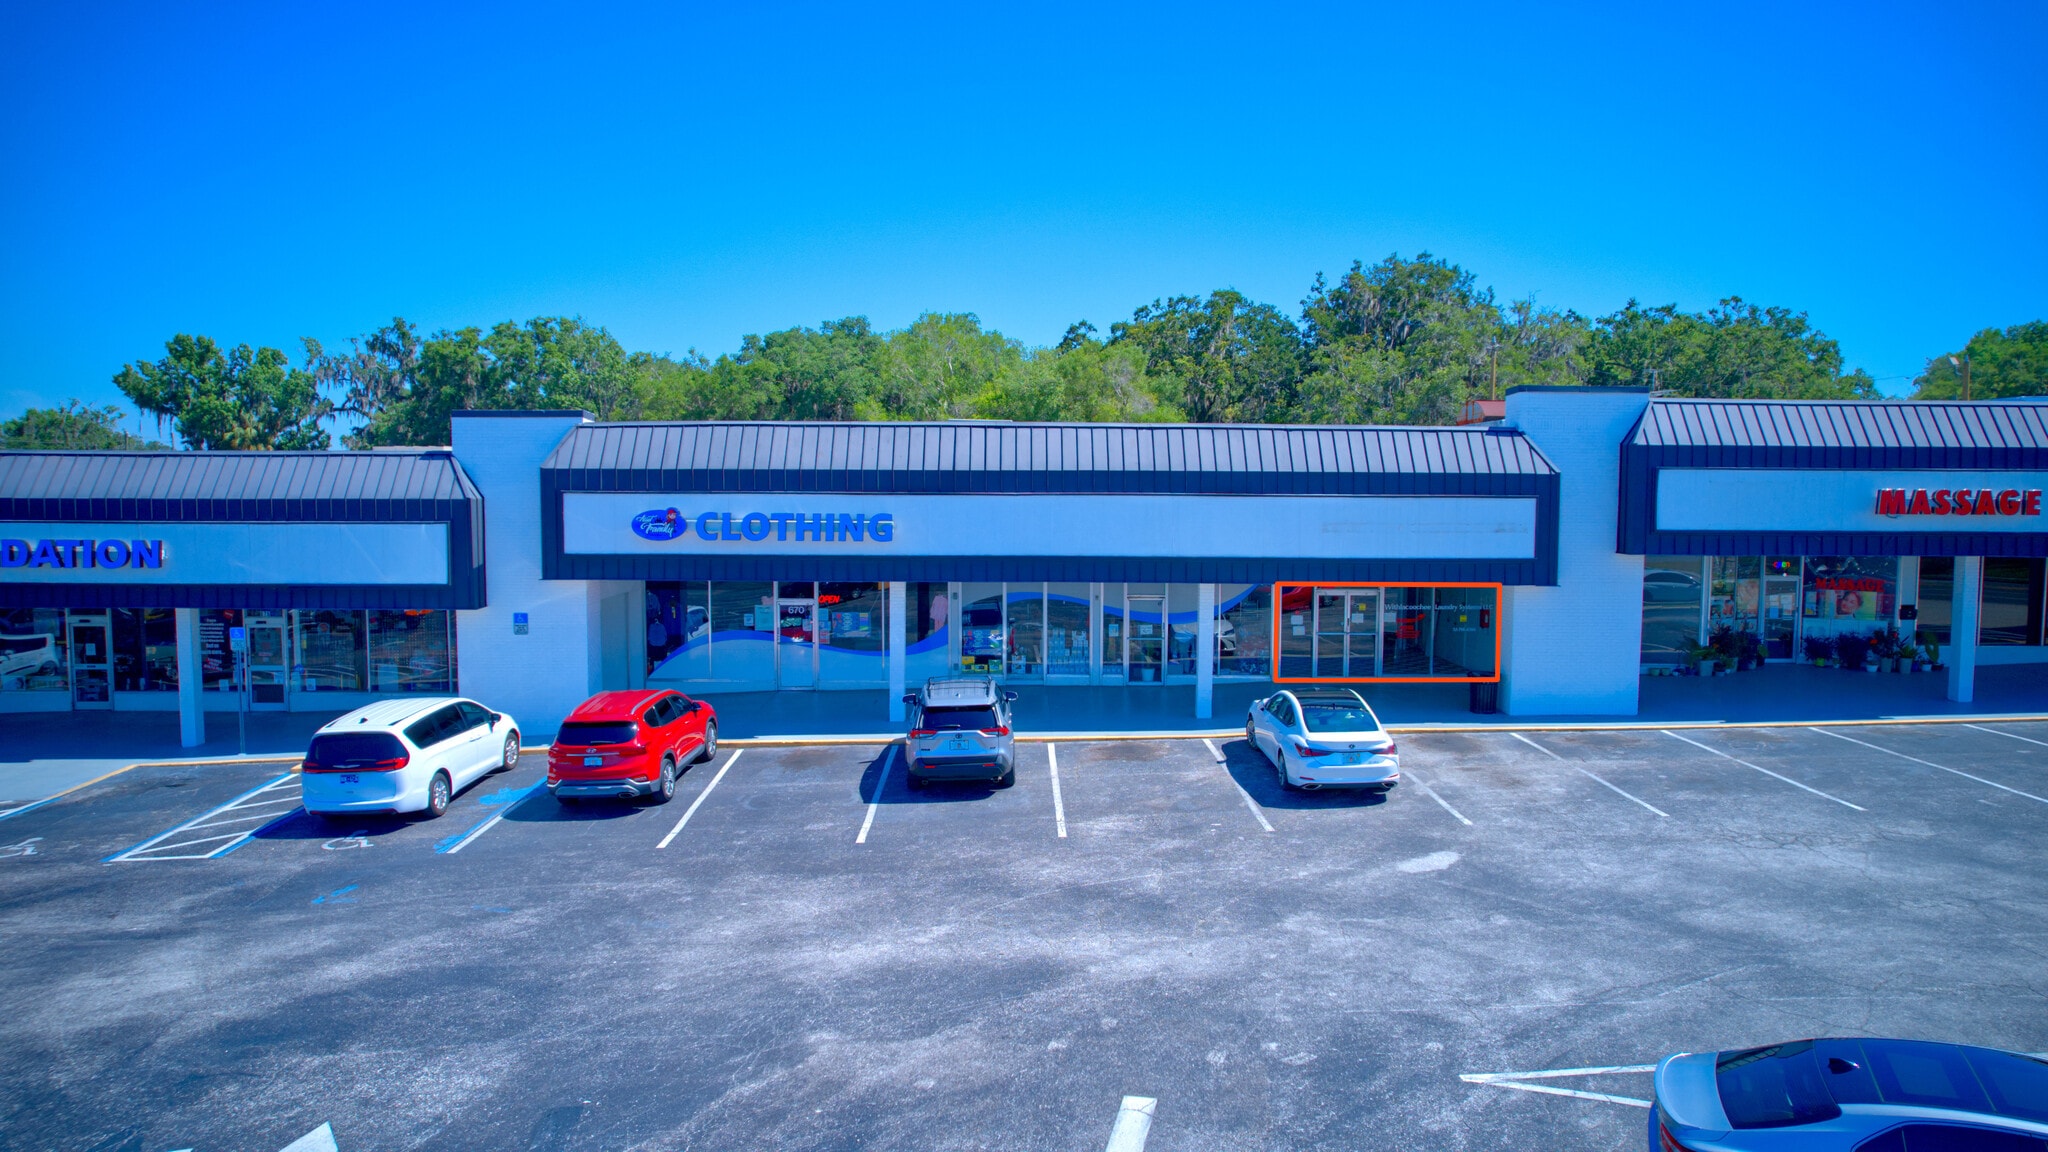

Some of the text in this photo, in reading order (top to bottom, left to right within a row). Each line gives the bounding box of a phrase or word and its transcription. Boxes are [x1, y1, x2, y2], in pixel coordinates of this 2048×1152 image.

[1876, 488, 2042, 516] MASSAGE
[695, 512, 893, 542] CLOTHING
[0, 539, 161, 569] DATION
[1815, 577, 1886, 593] MASSAGE
[788, 606, 805, 614] 670
[818, 595, 841, 604] OPEN
